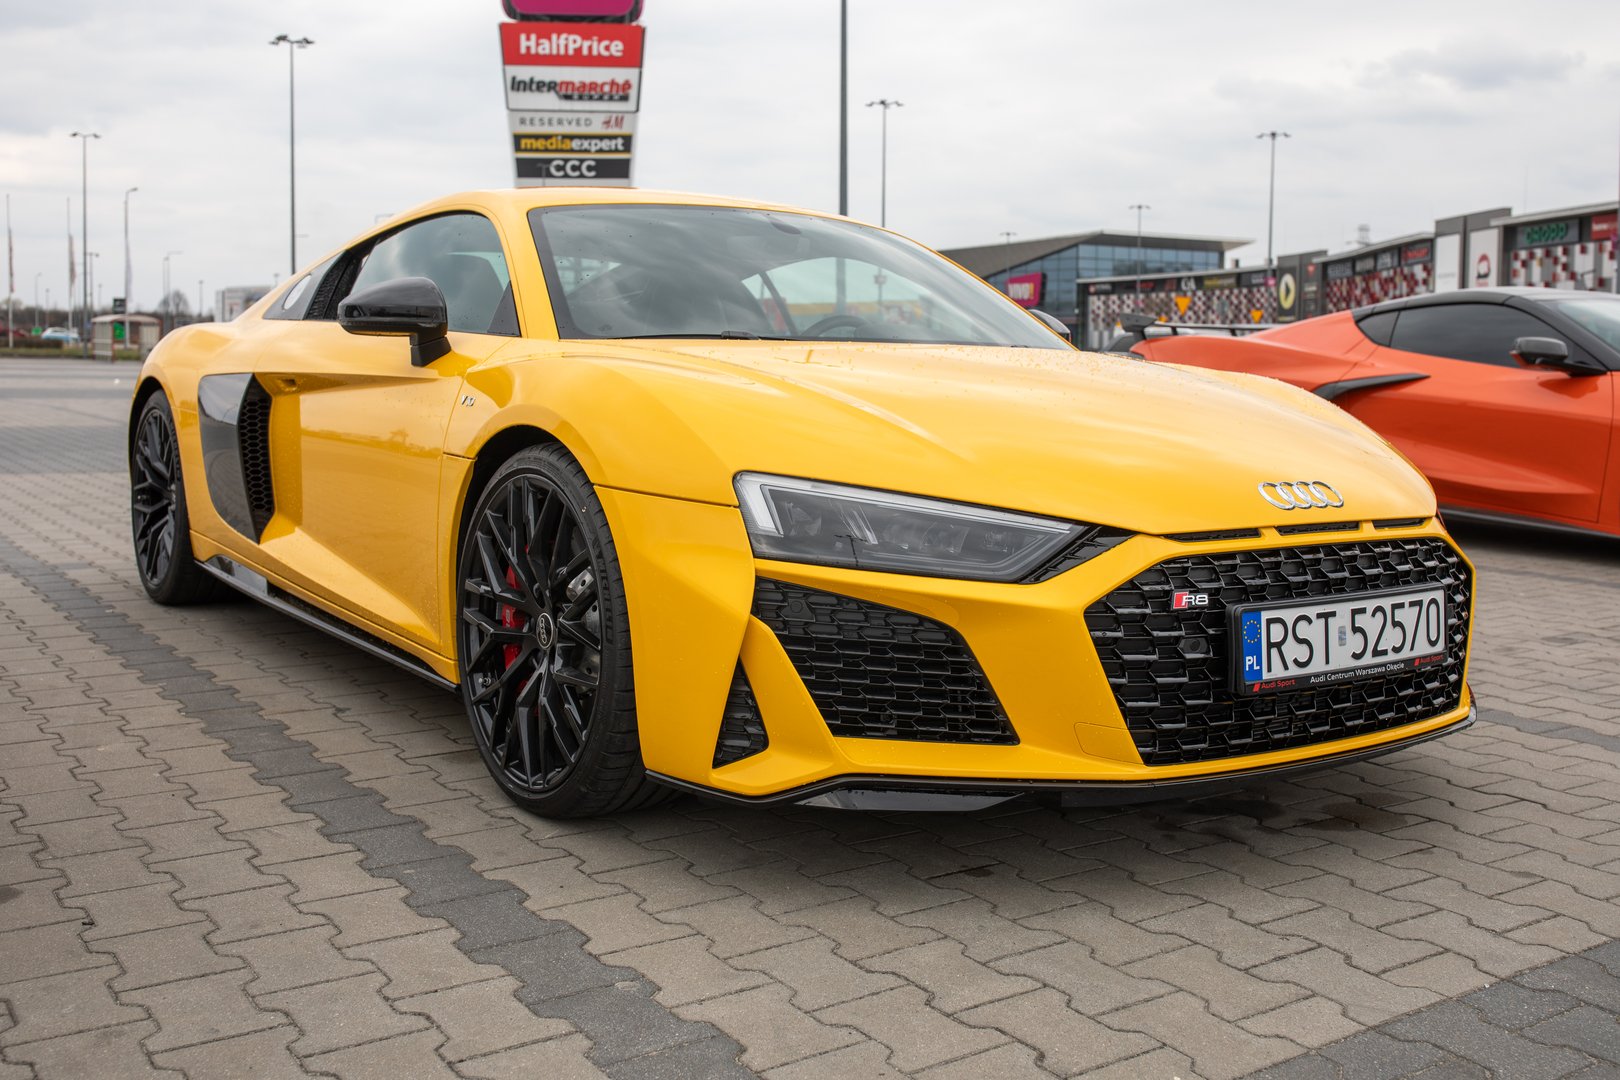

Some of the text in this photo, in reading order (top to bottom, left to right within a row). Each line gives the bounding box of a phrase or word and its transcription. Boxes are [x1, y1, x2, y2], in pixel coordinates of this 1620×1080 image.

[519, 32, 624, 57] HalfPrice
[511, 75, 632, 96] Intermarché
[519, 117, 593, 127] RESERVED
[549, 160, 597, 178] CCC
[1182, 594, 1209, 606] R8
[1265, 597, 1441, 673] RST 52570
[1245, 655, 1260, 671] PL
[1310, 662, 1405, 684] Audi Centrum Warszawa Okęcie
[1261, 678, 1296, 690] Audi Sport
